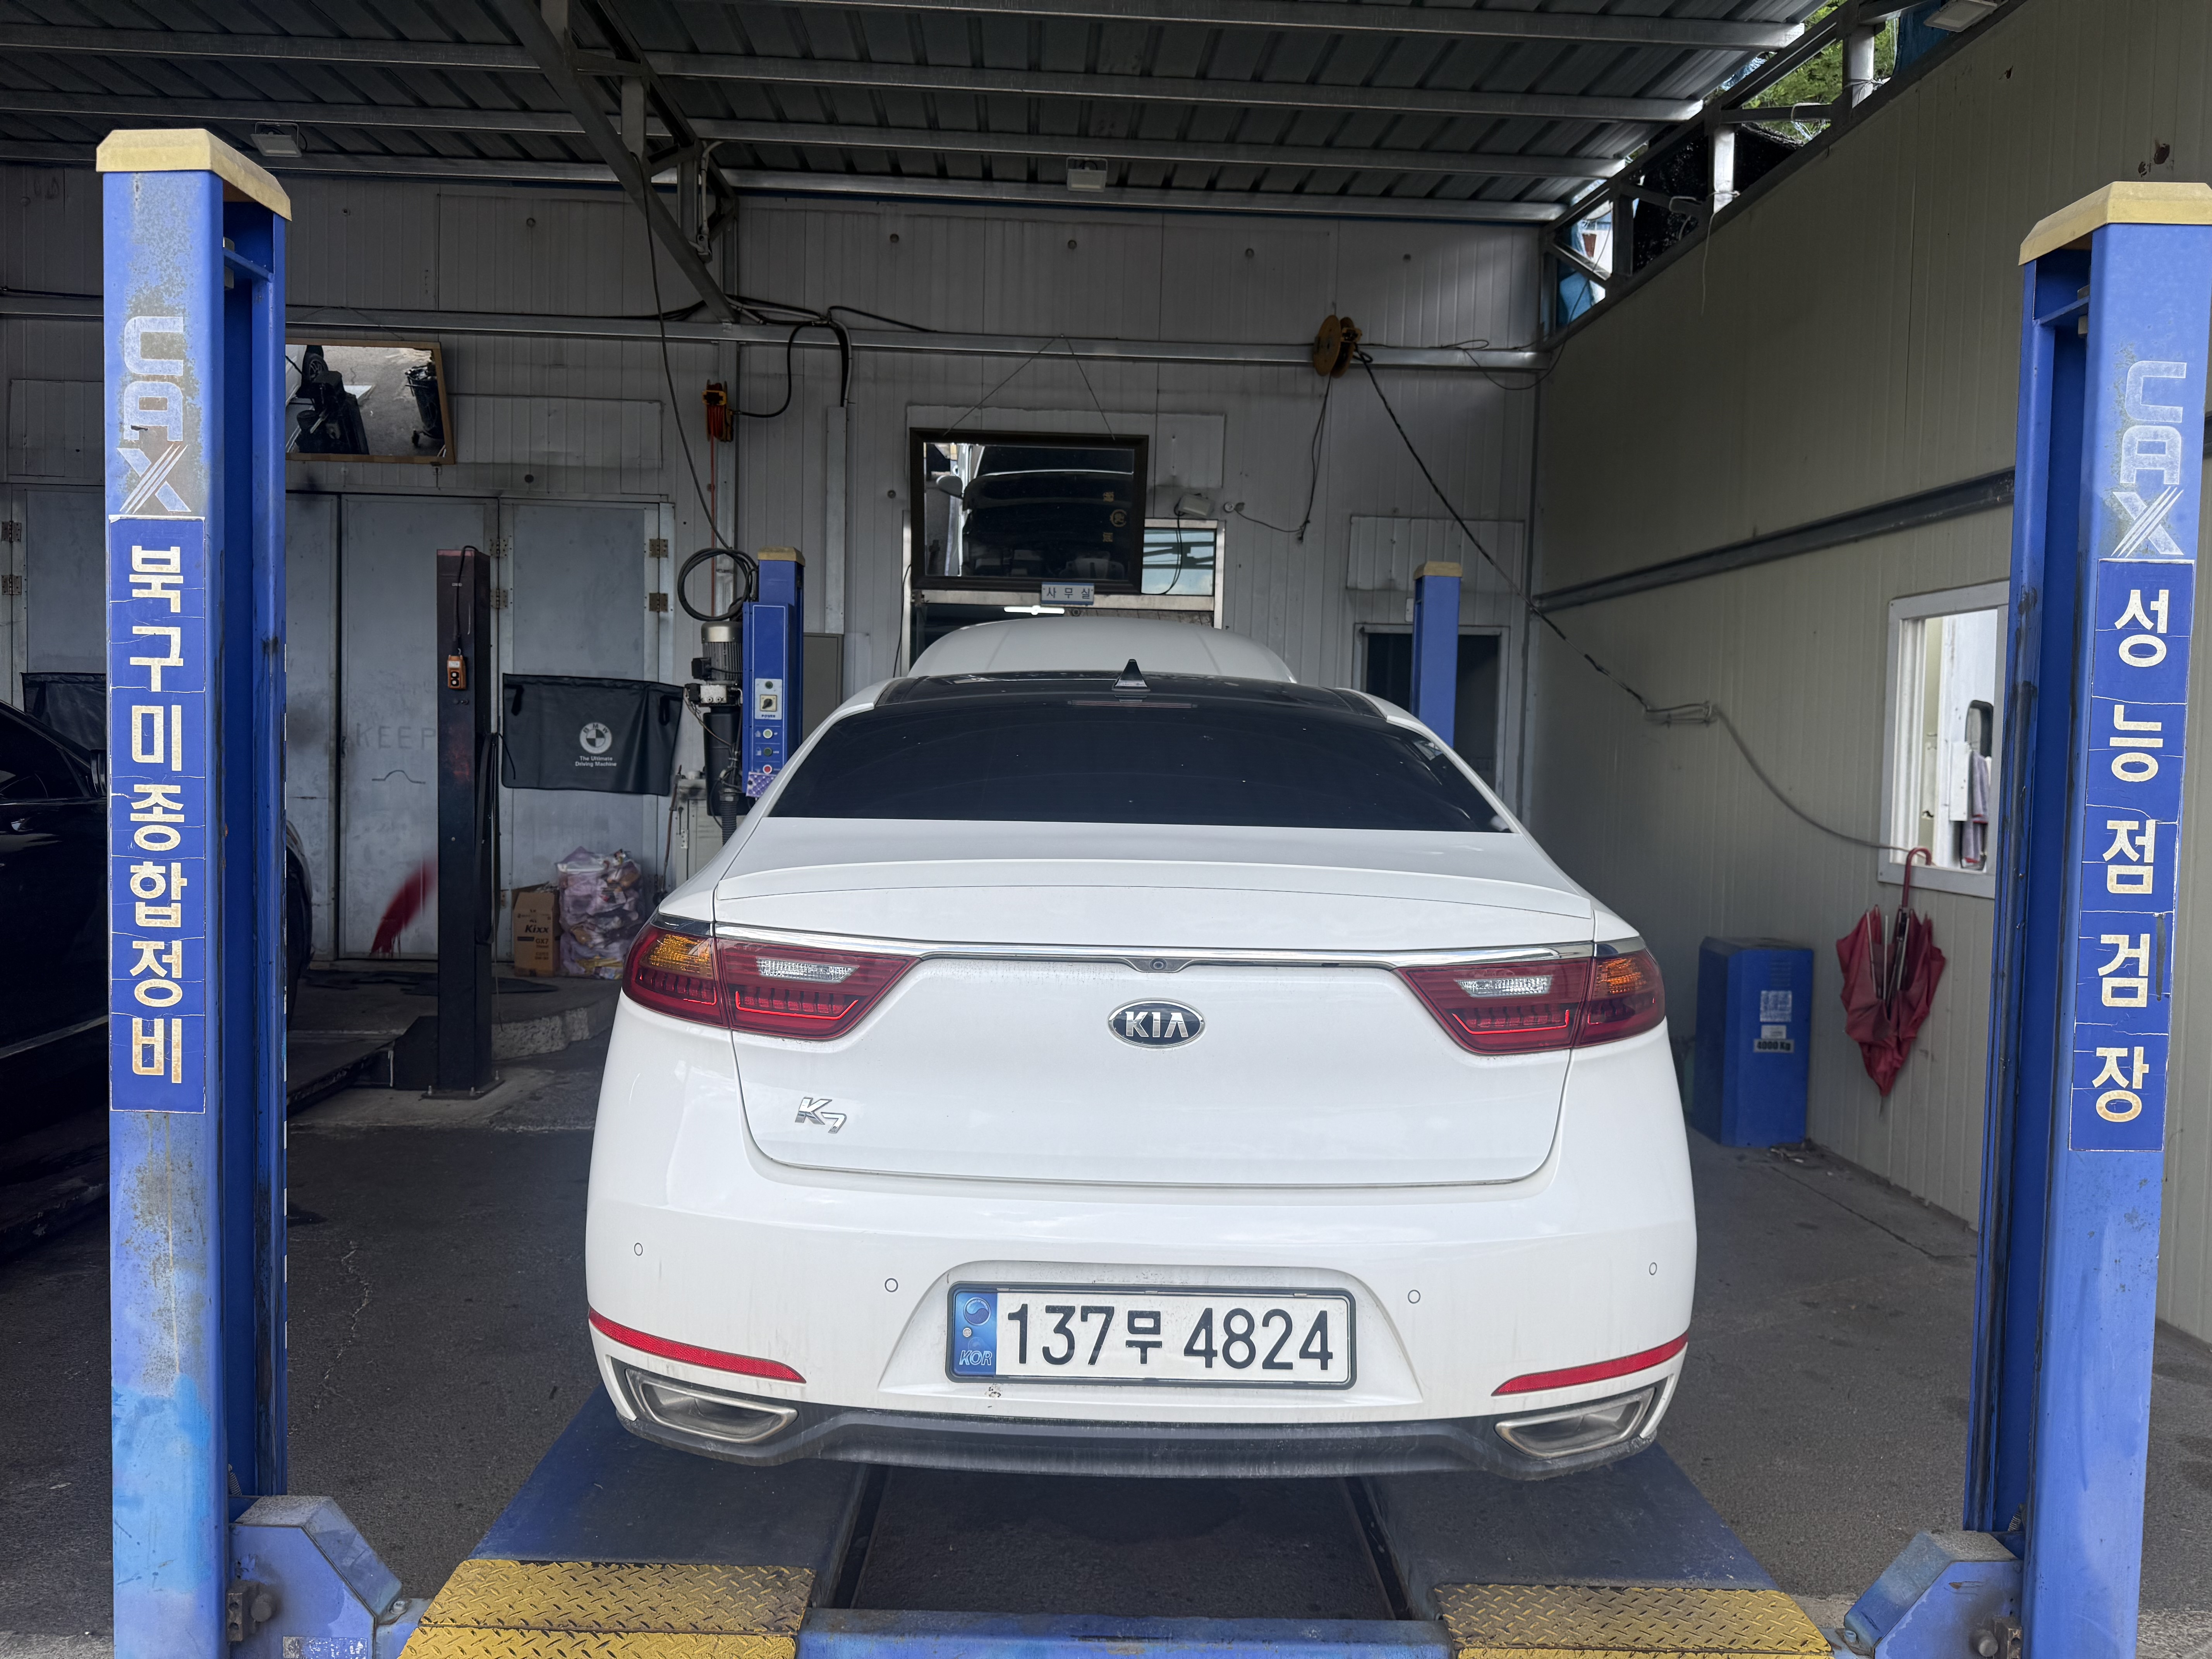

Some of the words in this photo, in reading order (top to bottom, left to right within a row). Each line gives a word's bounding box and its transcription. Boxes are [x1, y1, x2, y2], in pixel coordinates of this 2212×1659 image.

[356, 723, 436, 750] KEEP
[582, 723, 609, 734] BMW
[129, 545, 187, 1084] 북구미종합정비
[2092, 589, 2169, 1123] 성능점검장
[525, 924, 549, 933] Kixx
[1125, 1011, 1189, 1038] KIA
[795, 1096, 847, 1134] K7
[1007, 1303, 1163, 1366] 137무
[1183, 1307, 1334, 1371] 4824
[959, 1350, 993, 1366] KOR
